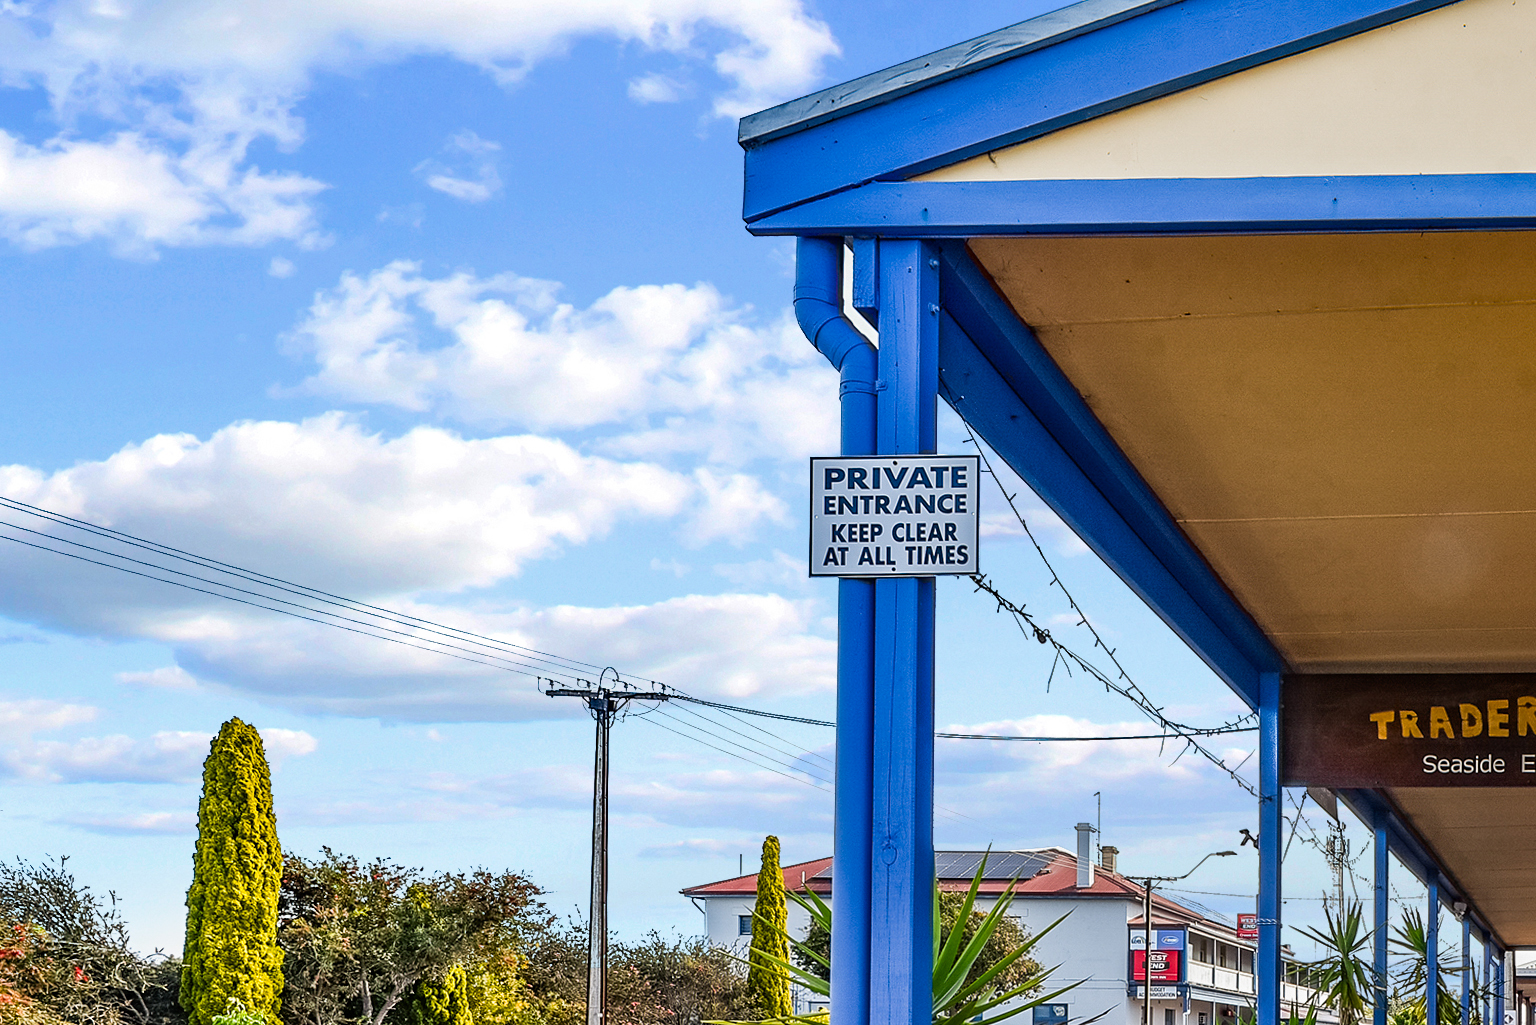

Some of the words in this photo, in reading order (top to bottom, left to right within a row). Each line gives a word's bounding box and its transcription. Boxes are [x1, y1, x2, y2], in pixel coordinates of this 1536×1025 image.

[823, 465, 968, 490] PRIVATE
[823, 494, 967, 515] ENTRANCE
[831, 523, 883, 543] KEEP
[892, 522, 958, 542] CLEAR
[823, 547, 849, 566] AT
[858, 546, 896, 566] ALL
[905, 545, 969, 566] TIMES
[1422, 754, 1506, 774] Seaside
